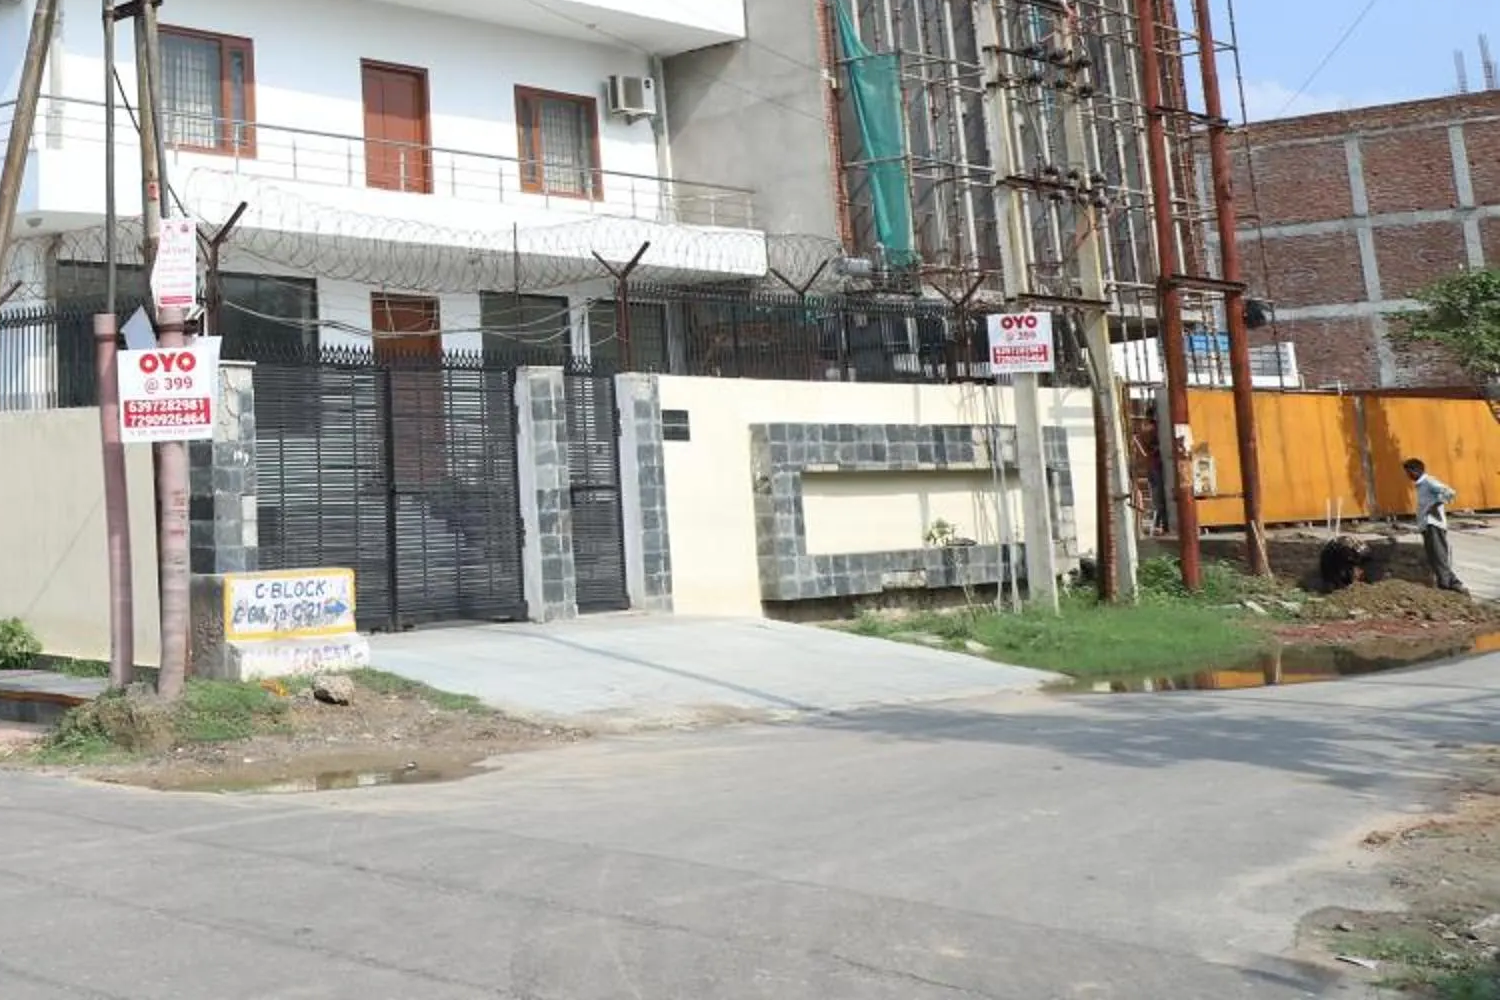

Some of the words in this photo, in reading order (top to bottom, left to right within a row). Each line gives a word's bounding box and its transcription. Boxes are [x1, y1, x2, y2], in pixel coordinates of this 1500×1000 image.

[1001, 315, 1037, 330] OYO
[139, 352, 196, 374] OYO
[144, 378, 159, 394] @
[164, 376, 193, 390] 399
